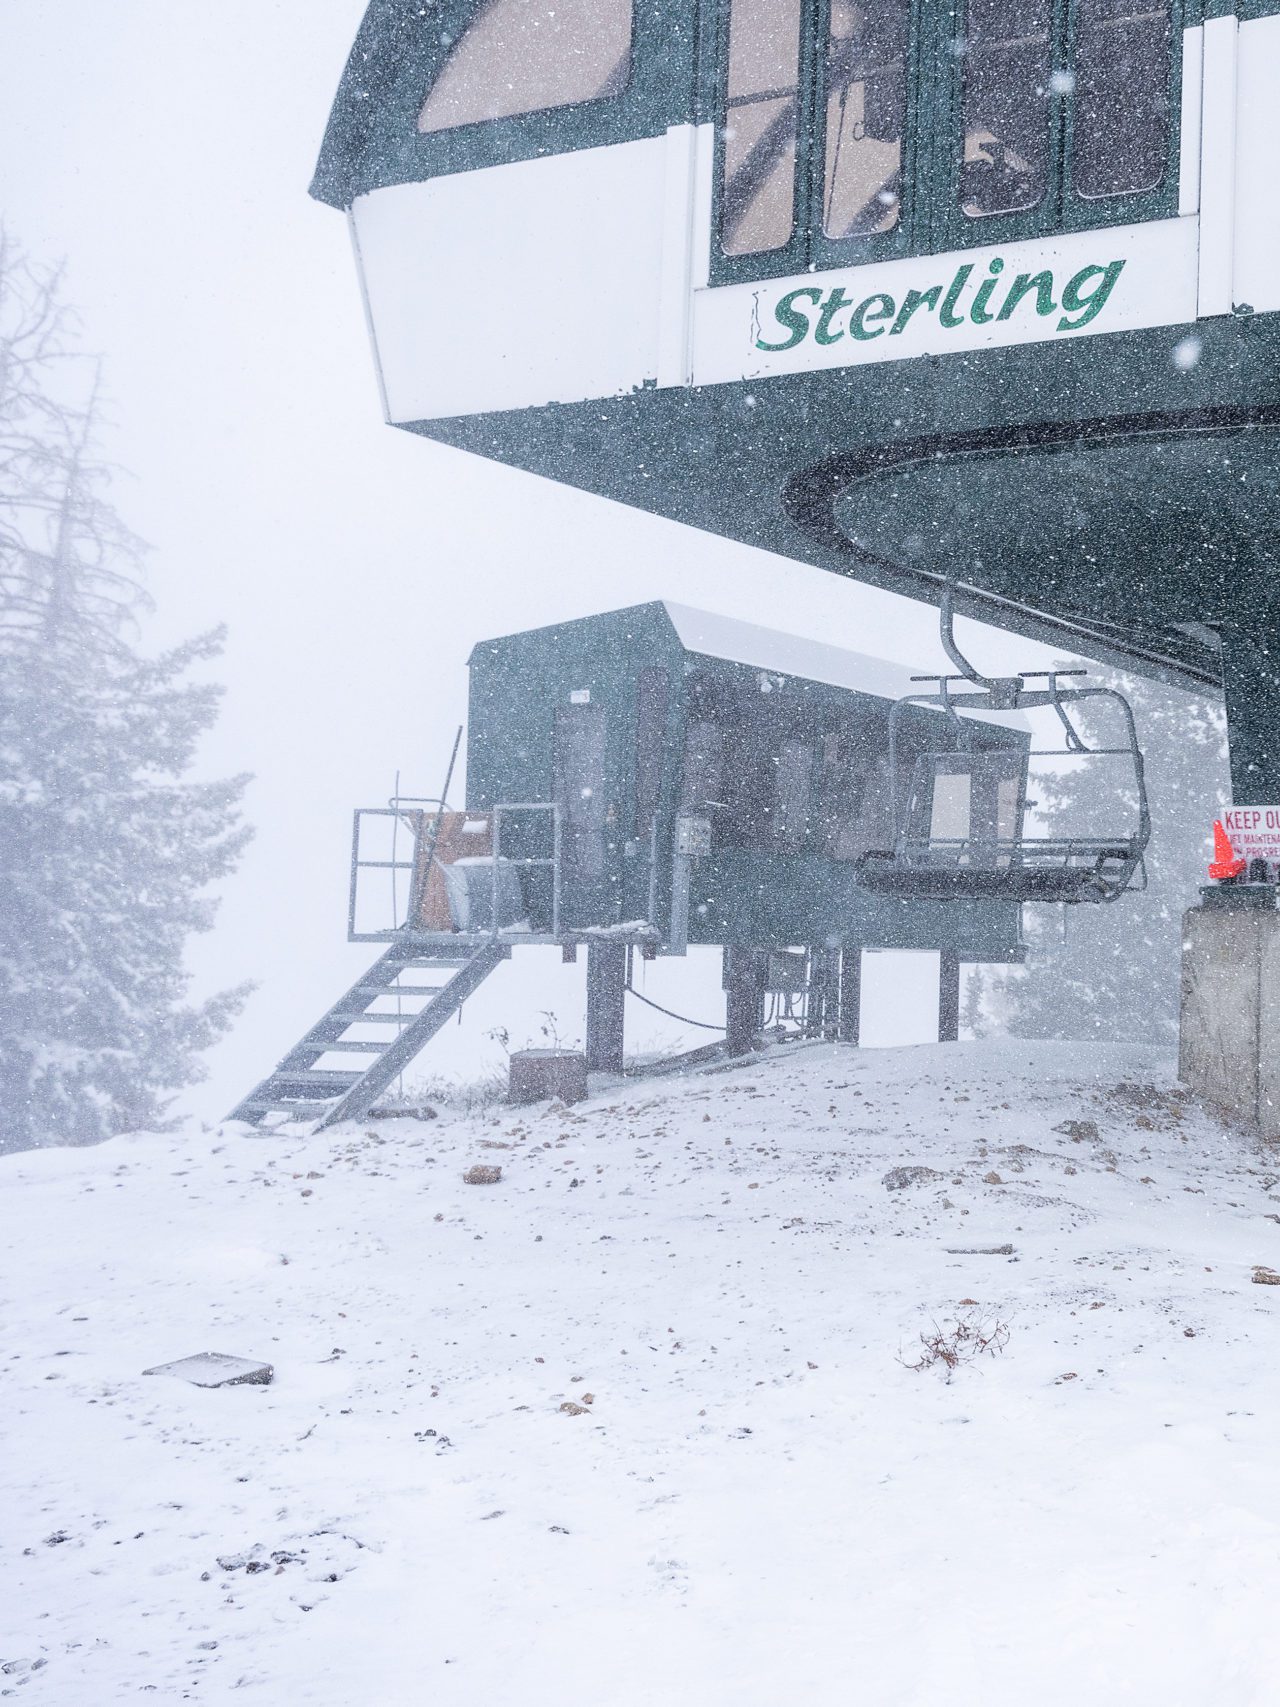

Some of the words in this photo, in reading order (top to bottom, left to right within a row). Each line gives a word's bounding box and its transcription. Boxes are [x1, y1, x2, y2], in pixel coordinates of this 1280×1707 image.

[755, 257, 1126, 350] Sterling
[1225, 811, 1261, 830] KEEP
[1229, 834, 1241, 845] IFT
